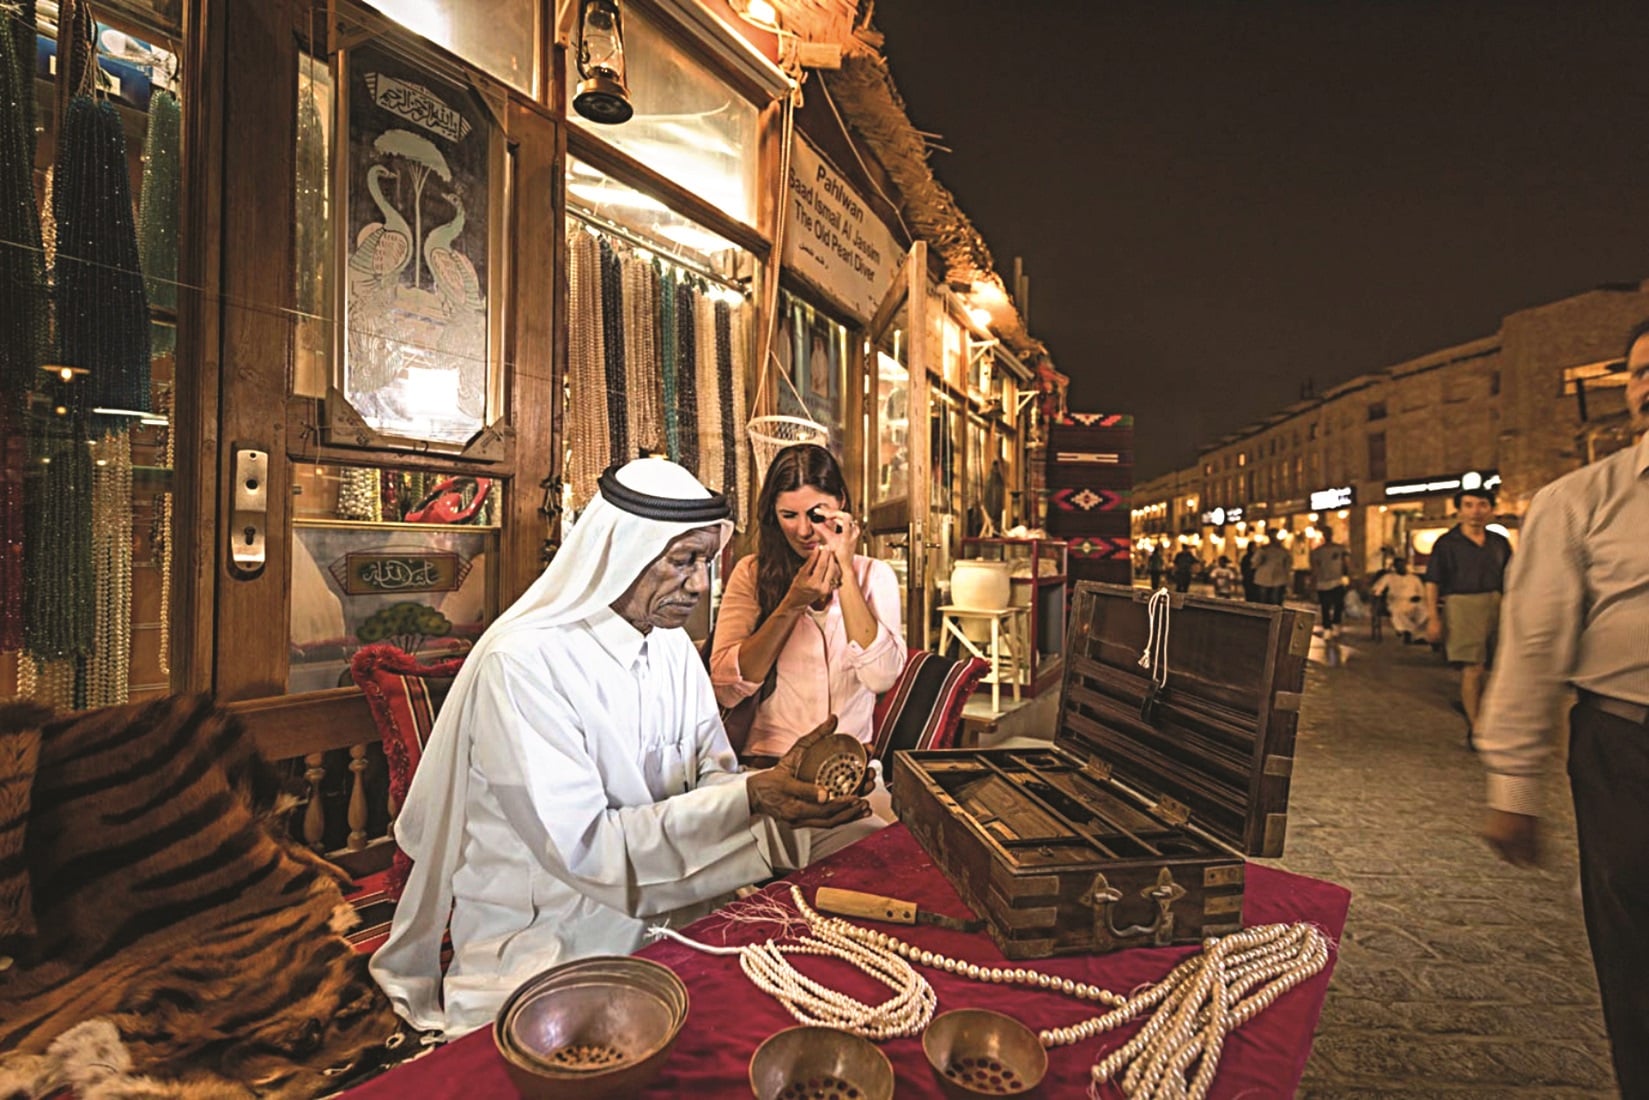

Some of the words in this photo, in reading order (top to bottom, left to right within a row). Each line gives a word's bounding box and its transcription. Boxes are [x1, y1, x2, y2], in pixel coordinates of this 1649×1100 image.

[815, 192, 841, 231] Ismail
[842, 220, 852, 240] Al
[853, 230, 880, 266] Jassim
[816, 165, 863, 224] Pahlwan
[795, 199, 812, 232] The
[815, 220, 830, 247] Old
[832, 234, 853, 267] Pearl
[855, 253, 875, 282] Diver
